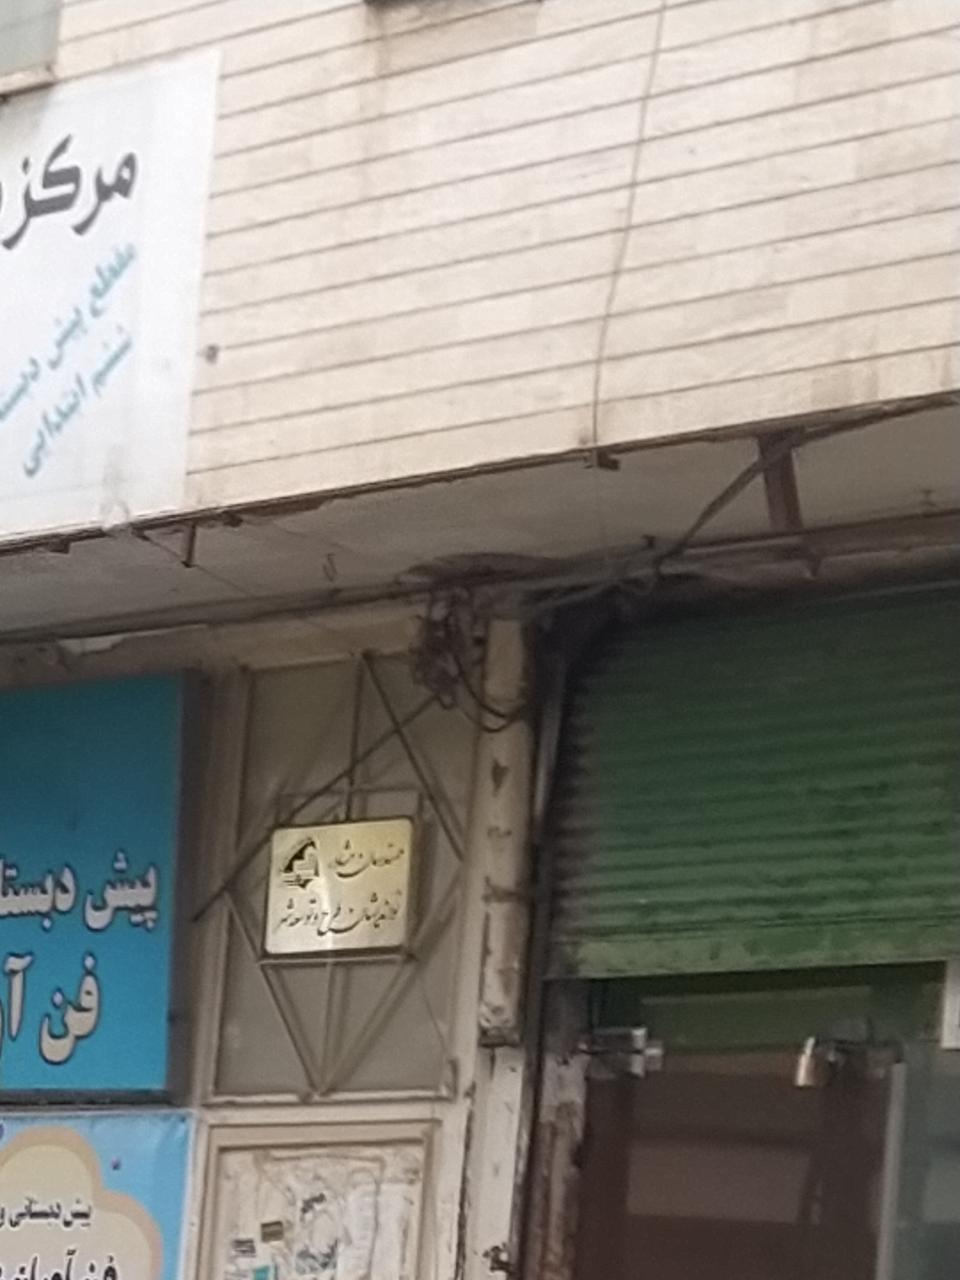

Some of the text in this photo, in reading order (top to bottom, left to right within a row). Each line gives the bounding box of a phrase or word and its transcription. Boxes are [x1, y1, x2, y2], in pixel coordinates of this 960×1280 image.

[2, 134, 138, 250] مرکز
[83, 849, 159, 933] پیش
[39, 951, 101, 1065] فن
[8, 1196, 62, 1228] دبستانی
[62, 1198, 93, 1228] پیش
